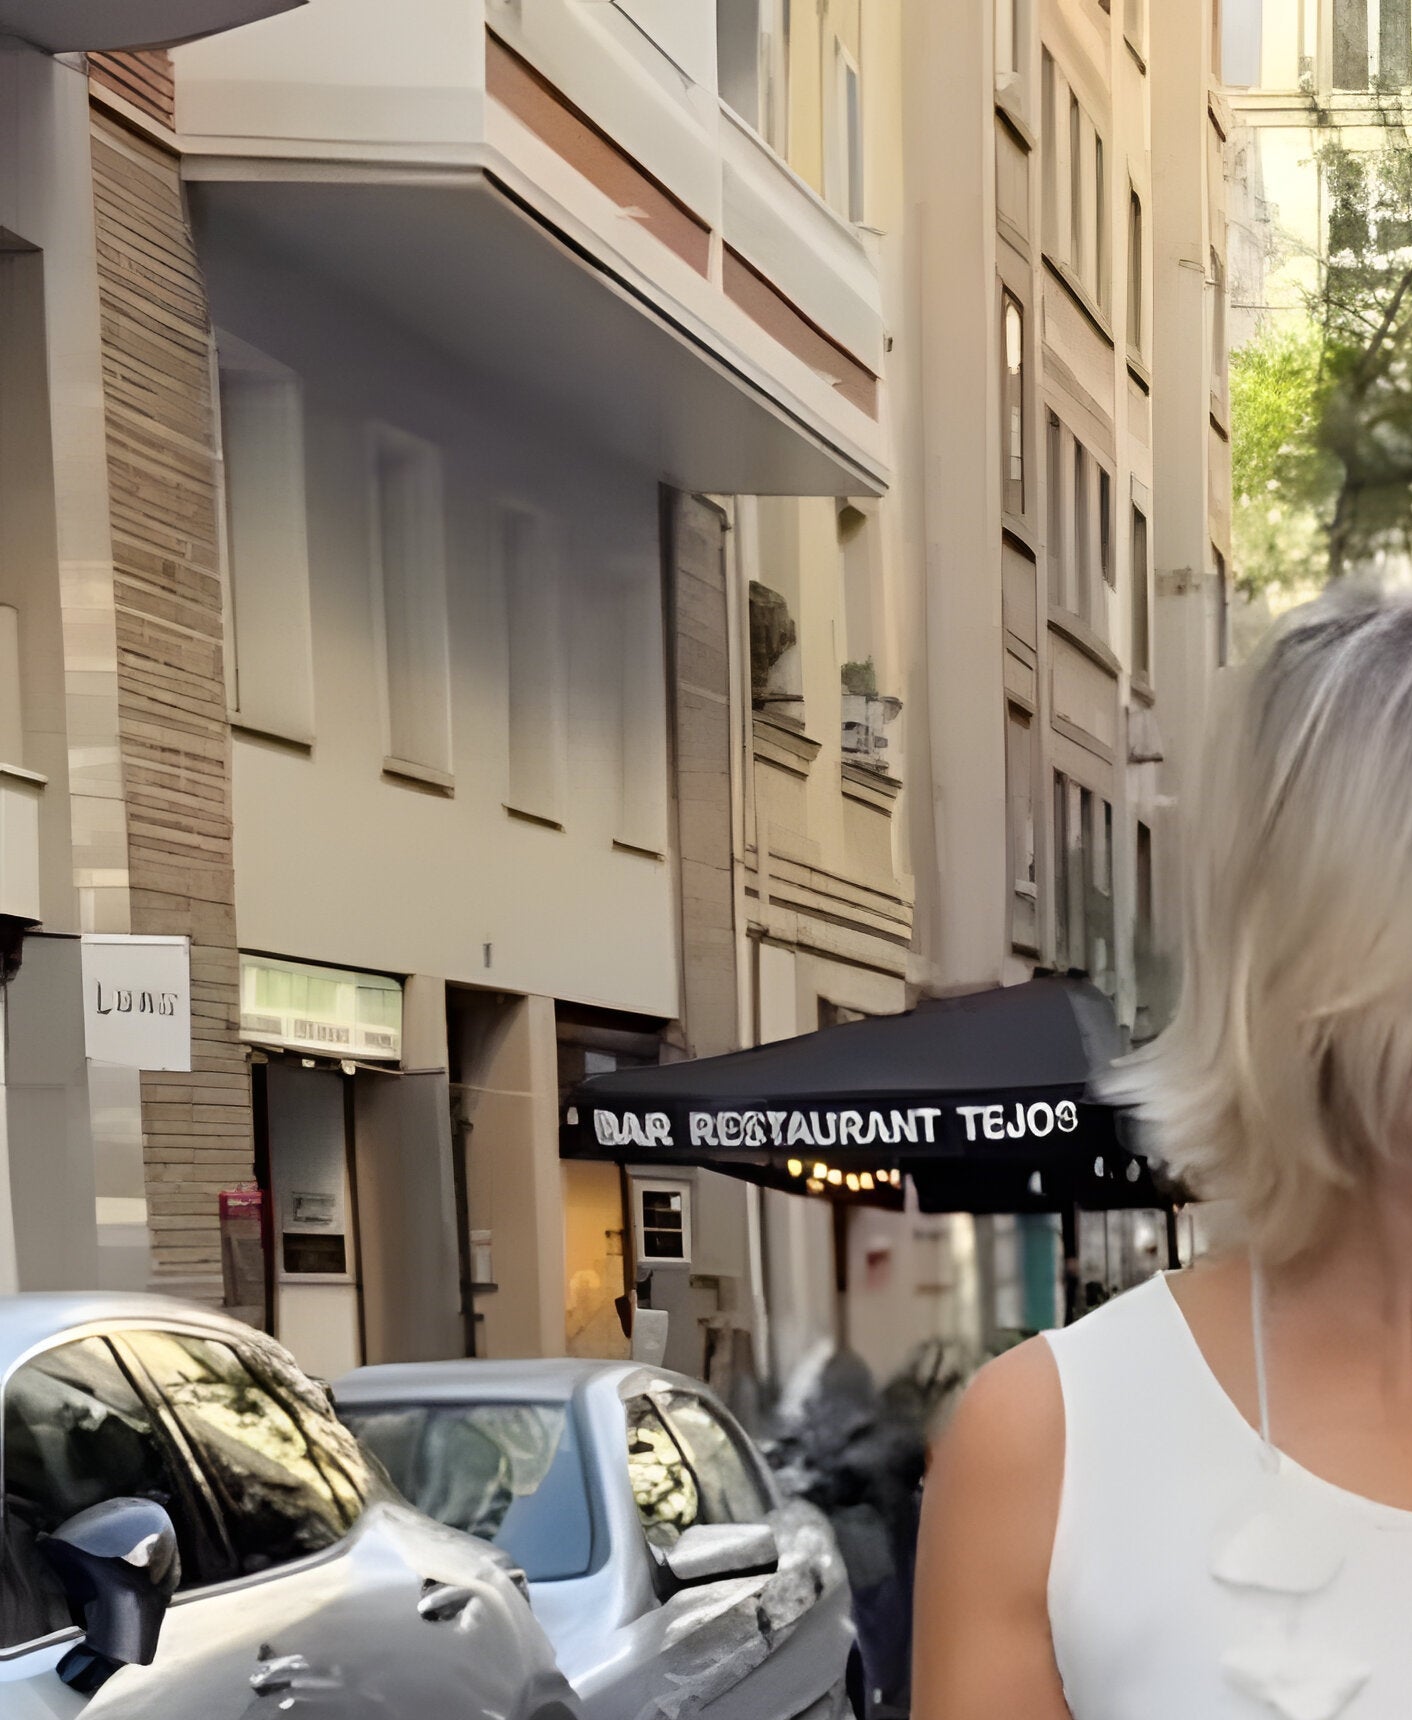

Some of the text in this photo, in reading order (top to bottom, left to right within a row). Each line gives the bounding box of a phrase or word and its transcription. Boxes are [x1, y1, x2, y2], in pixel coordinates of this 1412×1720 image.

[594, 1100, 1078, 1146] BAR RESTAURANT TEJOS
